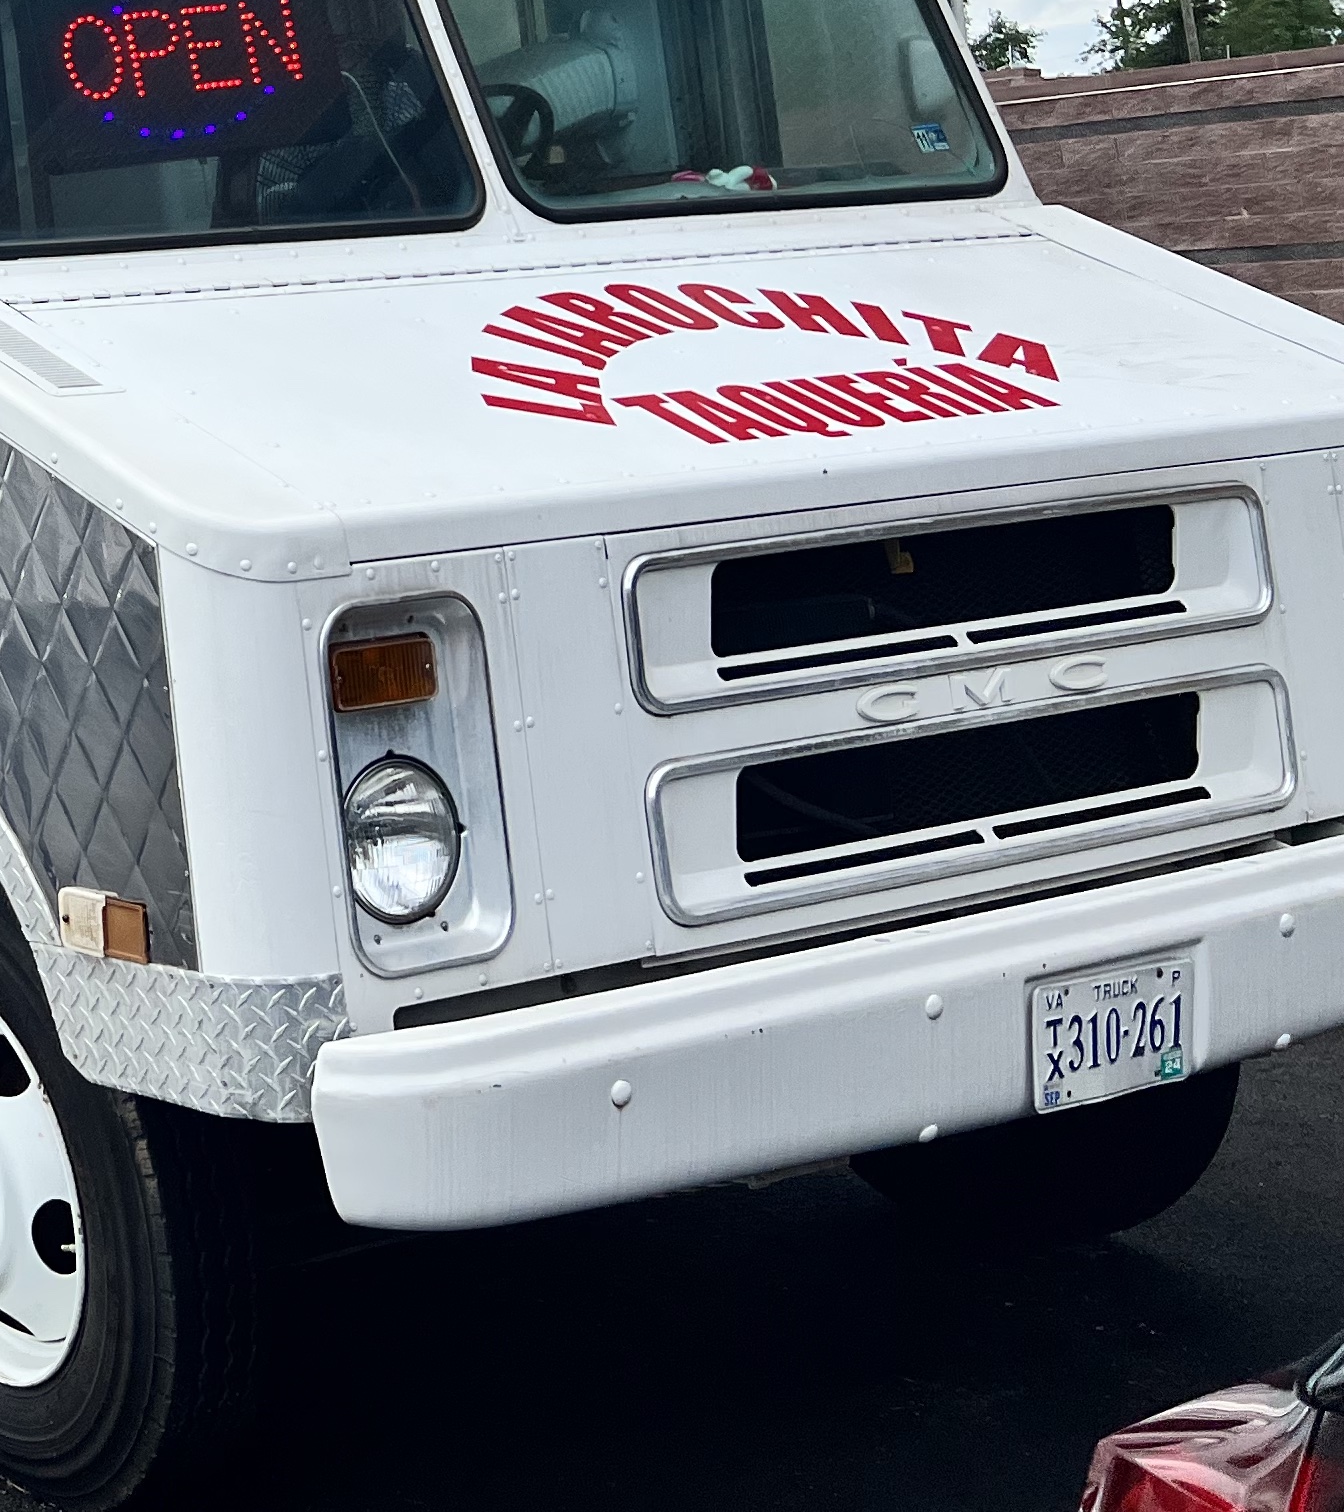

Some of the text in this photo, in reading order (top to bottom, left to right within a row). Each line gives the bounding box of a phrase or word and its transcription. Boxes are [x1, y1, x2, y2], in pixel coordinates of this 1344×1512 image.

[470, 283, 1060, 427] LA JAROCHITA
[1044, 976, 1139, 1011] VA TRUCK
[1068, 993, 1183, 1073] 310-261
[1044, 1090, 1060, 1106] SEP
